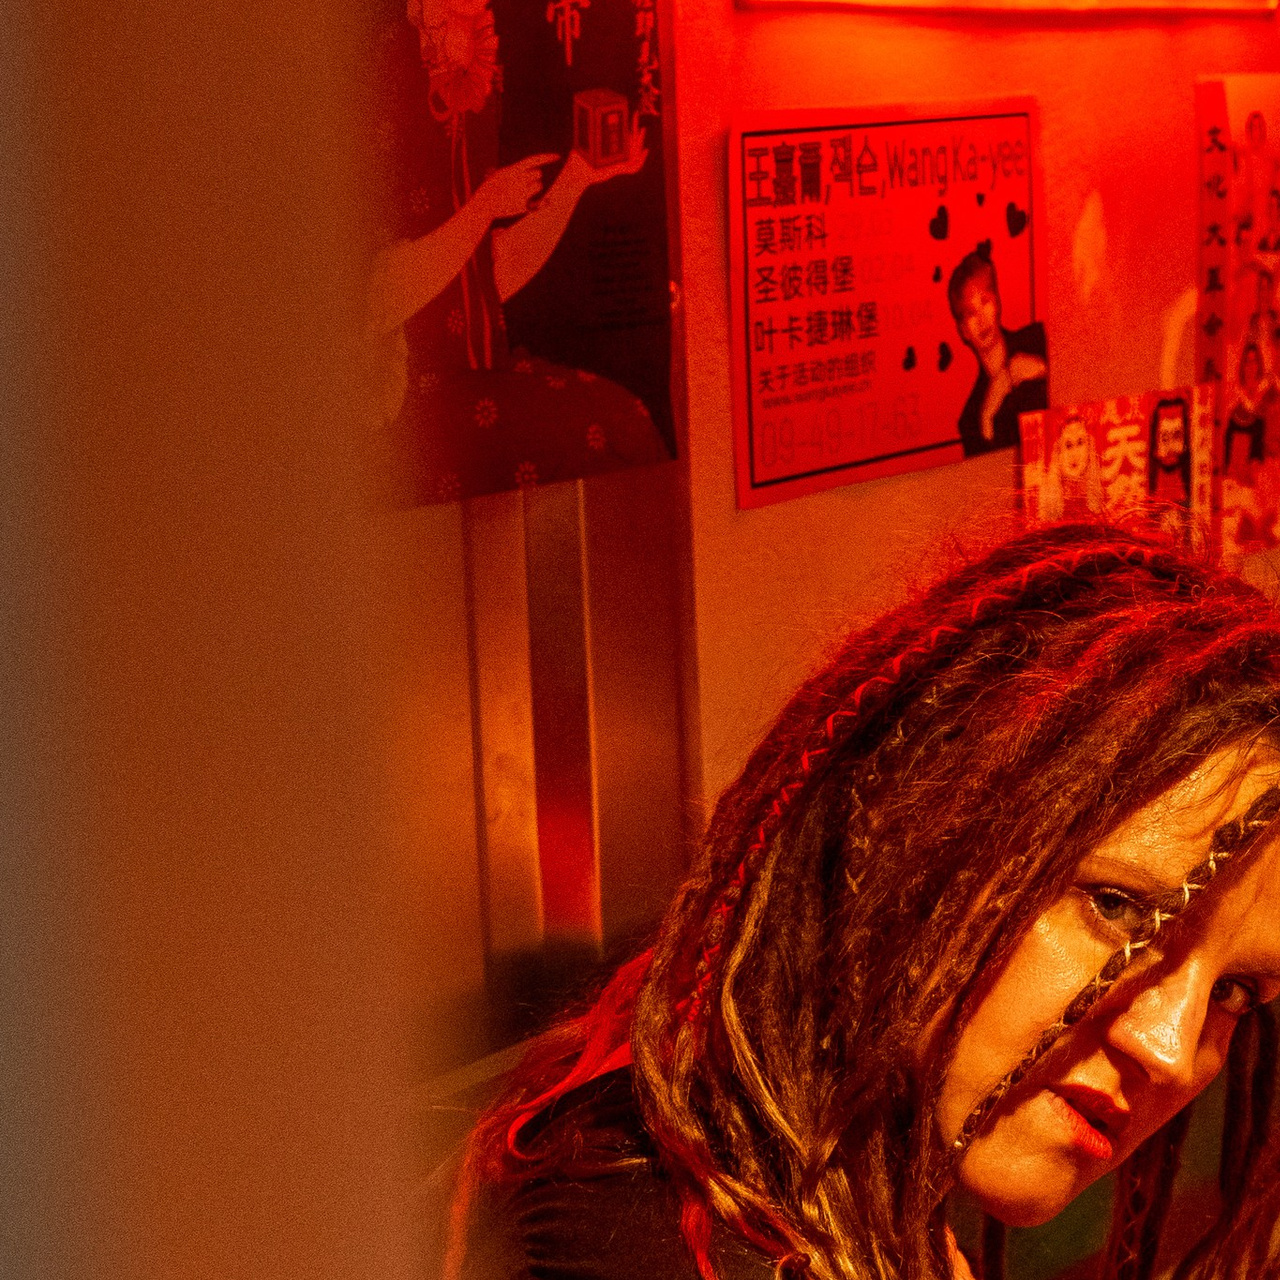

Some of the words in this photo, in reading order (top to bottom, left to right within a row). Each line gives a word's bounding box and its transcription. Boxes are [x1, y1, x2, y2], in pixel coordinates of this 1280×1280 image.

[755, 212, 828, 256] 莫斯科
[754, 254, 856, 305] 圣彼得堡
[753, 300, 881, 355] 叶卡捷琳堡
